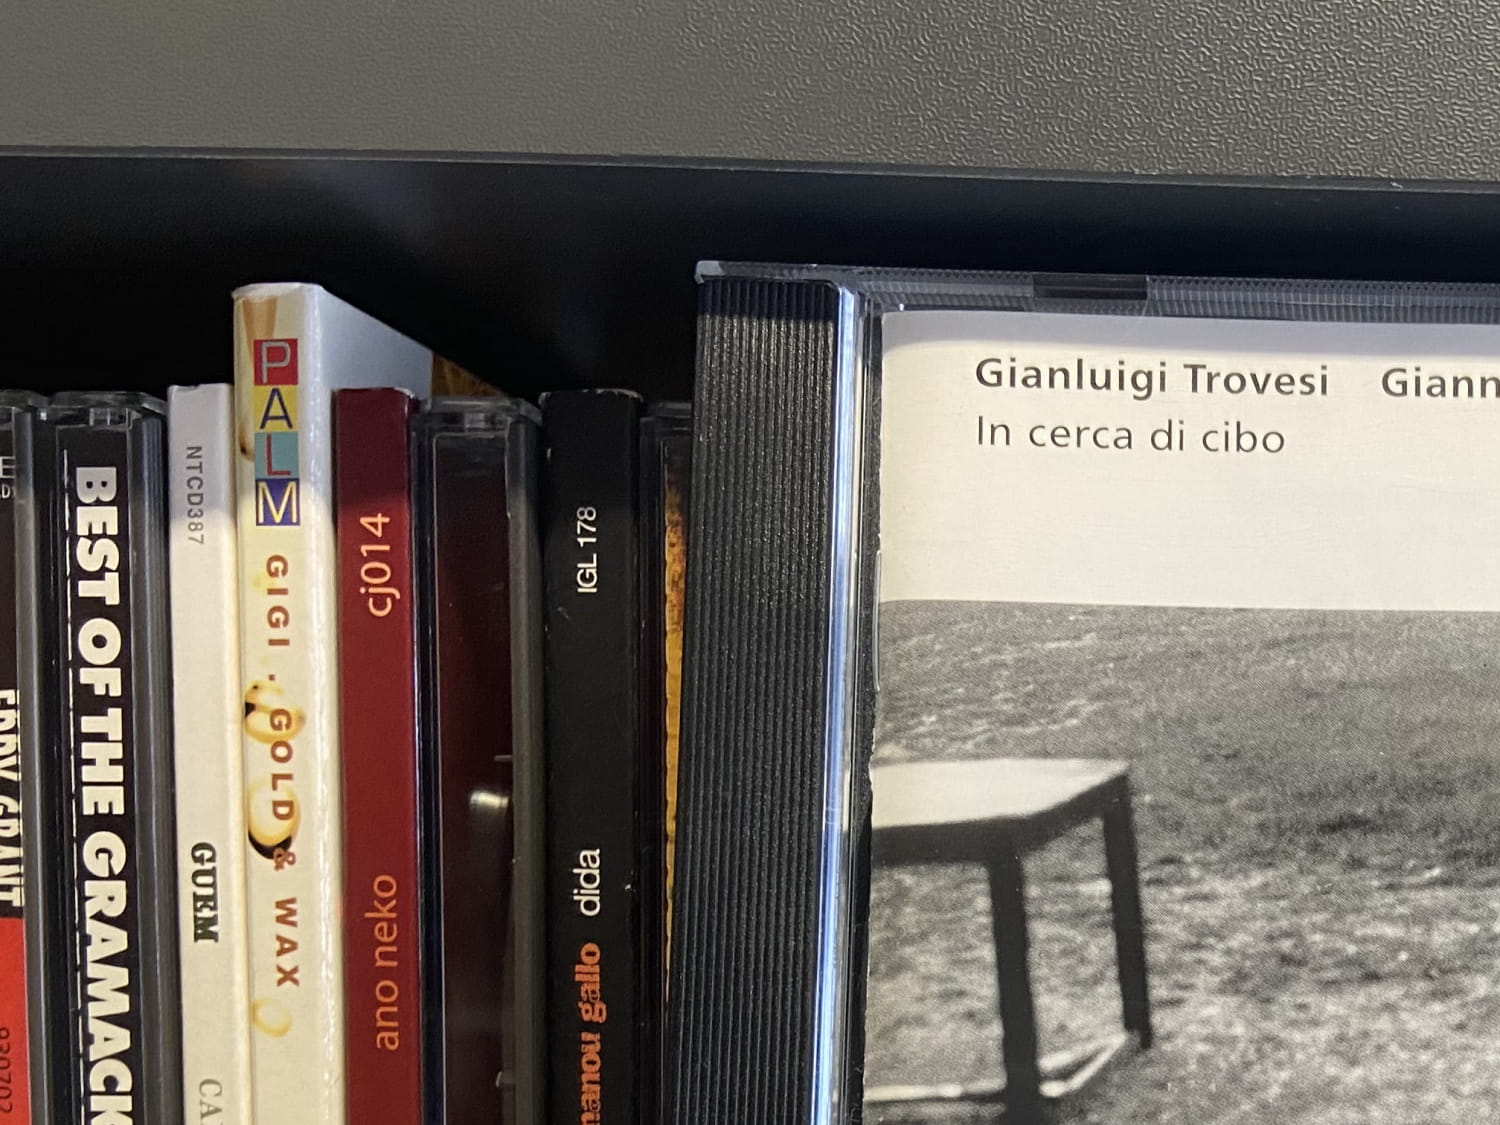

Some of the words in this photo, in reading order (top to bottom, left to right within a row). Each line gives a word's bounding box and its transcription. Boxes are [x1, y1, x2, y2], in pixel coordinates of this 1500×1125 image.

[974, 357, 1168, 401] Gianluigi
[1183, 363, 1330, 397] Trovesi
[257, 340, 299, 524] PALM
[976, 415, 1011, 447] In
[1028, 424, 1134, 450] cerca
[1150, 419, 1186, 454] di
[1201, 421, 1287, 456] cibo
[76, 466, 121, 606] BEST
[186, 446, 204, 545] NTCD387
[575, 505, 597, 549] 178
[266, 554, 291, 647] GIGI
[360, 512, 401, 618] cj014
[577, 557, 598, 594] IGL
[78, 618, 123, 697] OF
[80, 707, 126, 816] THE
[269, 707, 296, 821] GOLD
[191, 841, 220, 943] GUEM
[364, 874, 400, 969] neko
[572, 848, 601, 917] dida
[274, 897, 301, 988] WAX
[574, 941, 608, 1023] gallo
[376, 980, 401, 1052] ano
